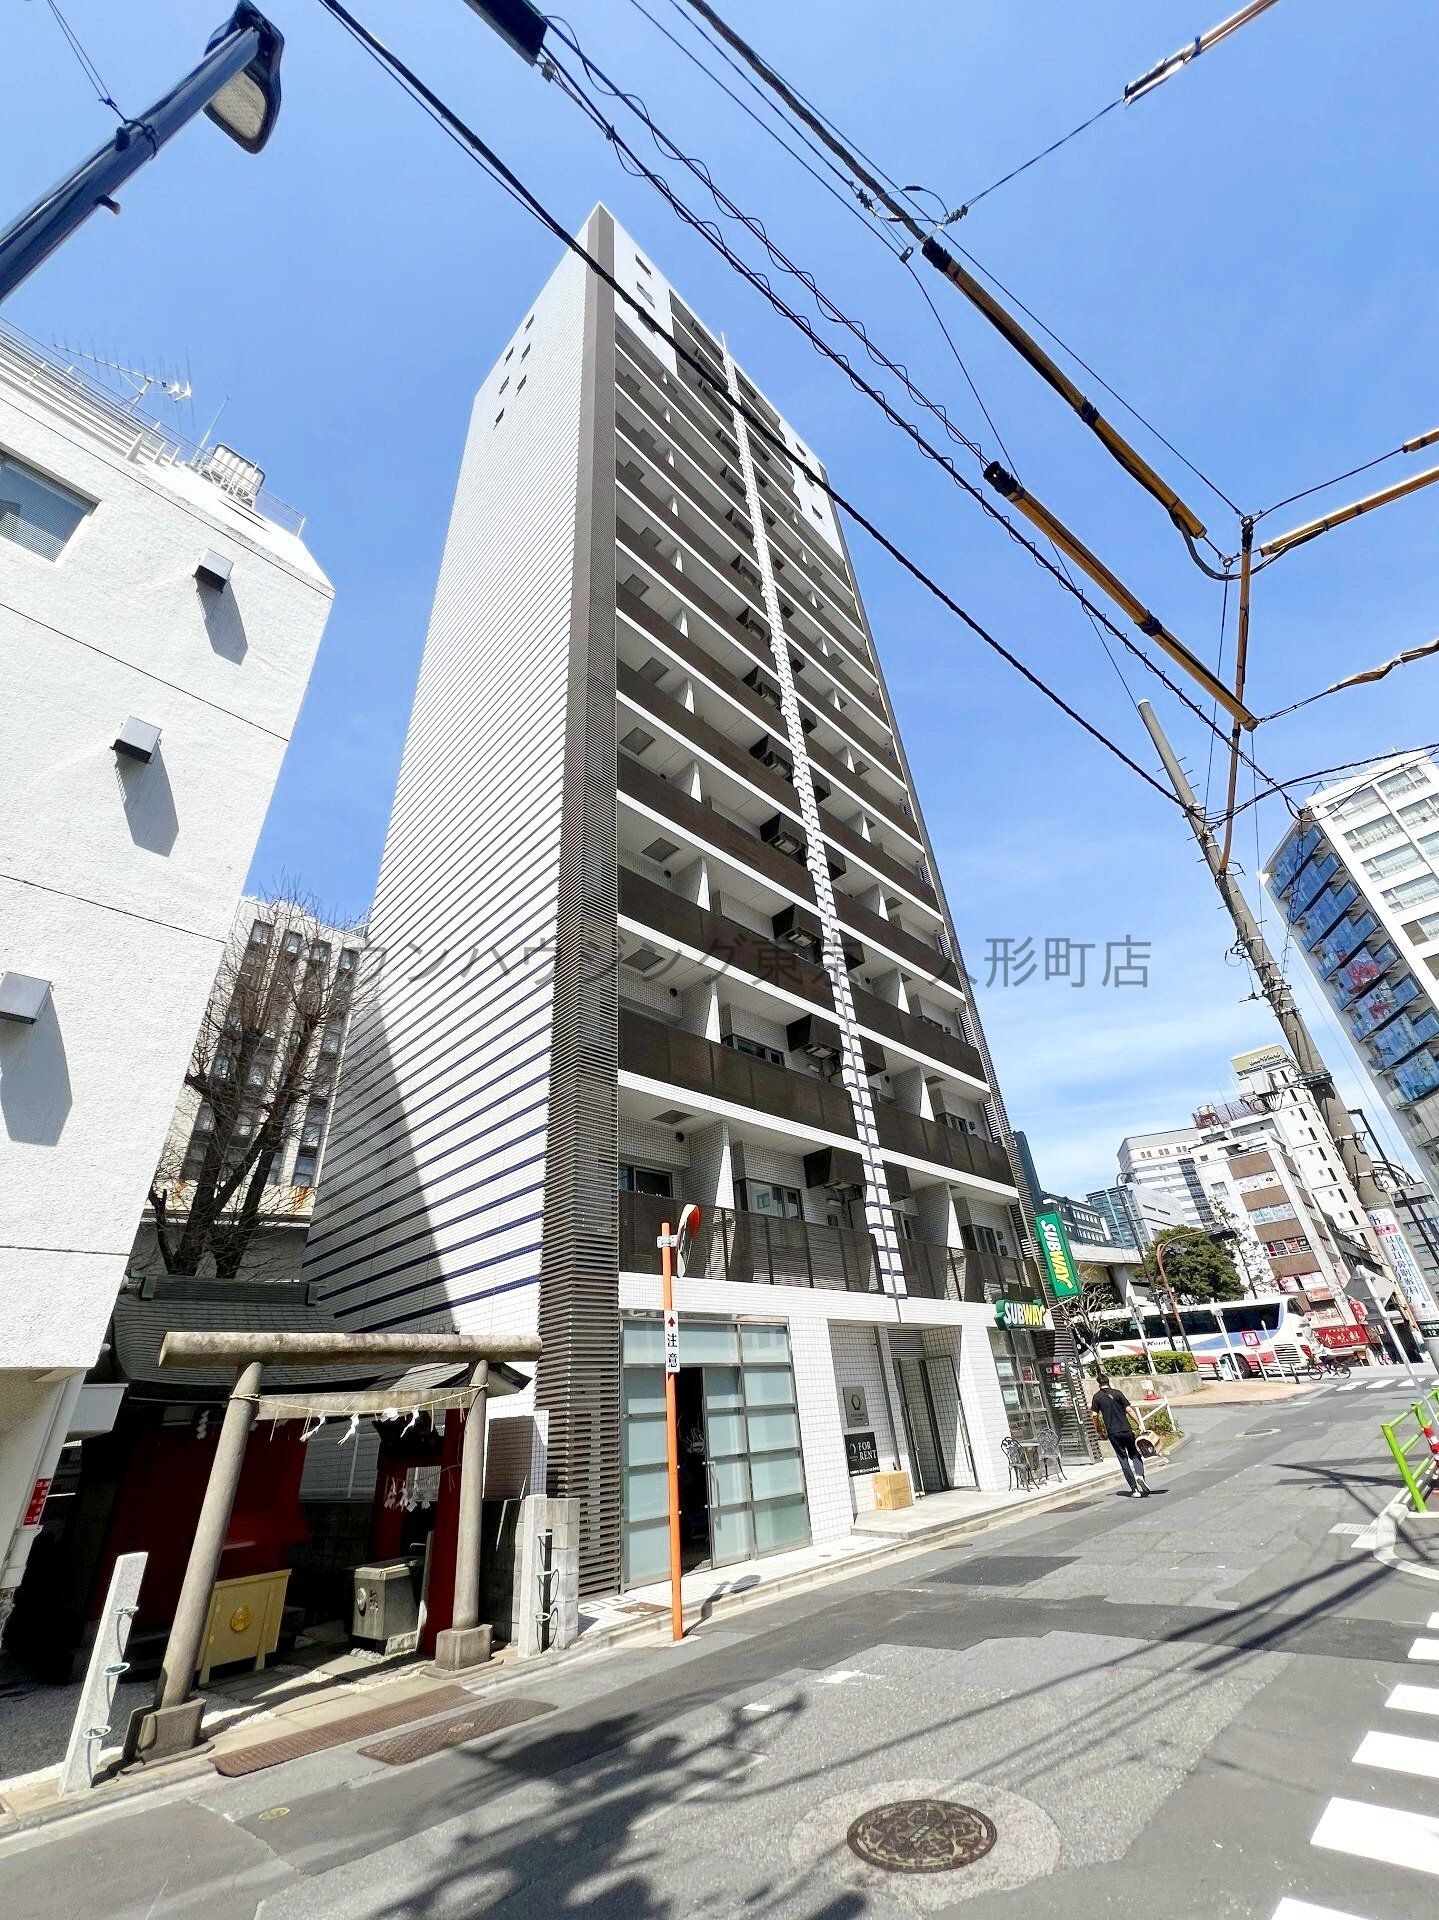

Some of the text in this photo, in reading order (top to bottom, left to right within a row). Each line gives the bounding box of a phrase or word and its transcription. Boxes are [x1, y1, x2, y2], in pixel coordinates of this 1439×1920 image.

[1040, 1219, 1074, 1290] SUBWAY
[1003, 1301, 1046, 1326] SUBWAY
[667, 1333, 678, 1368] 注意
[858, 1441, 872, 1451] FOR
[859, 1449, 877, 1461] RENT
